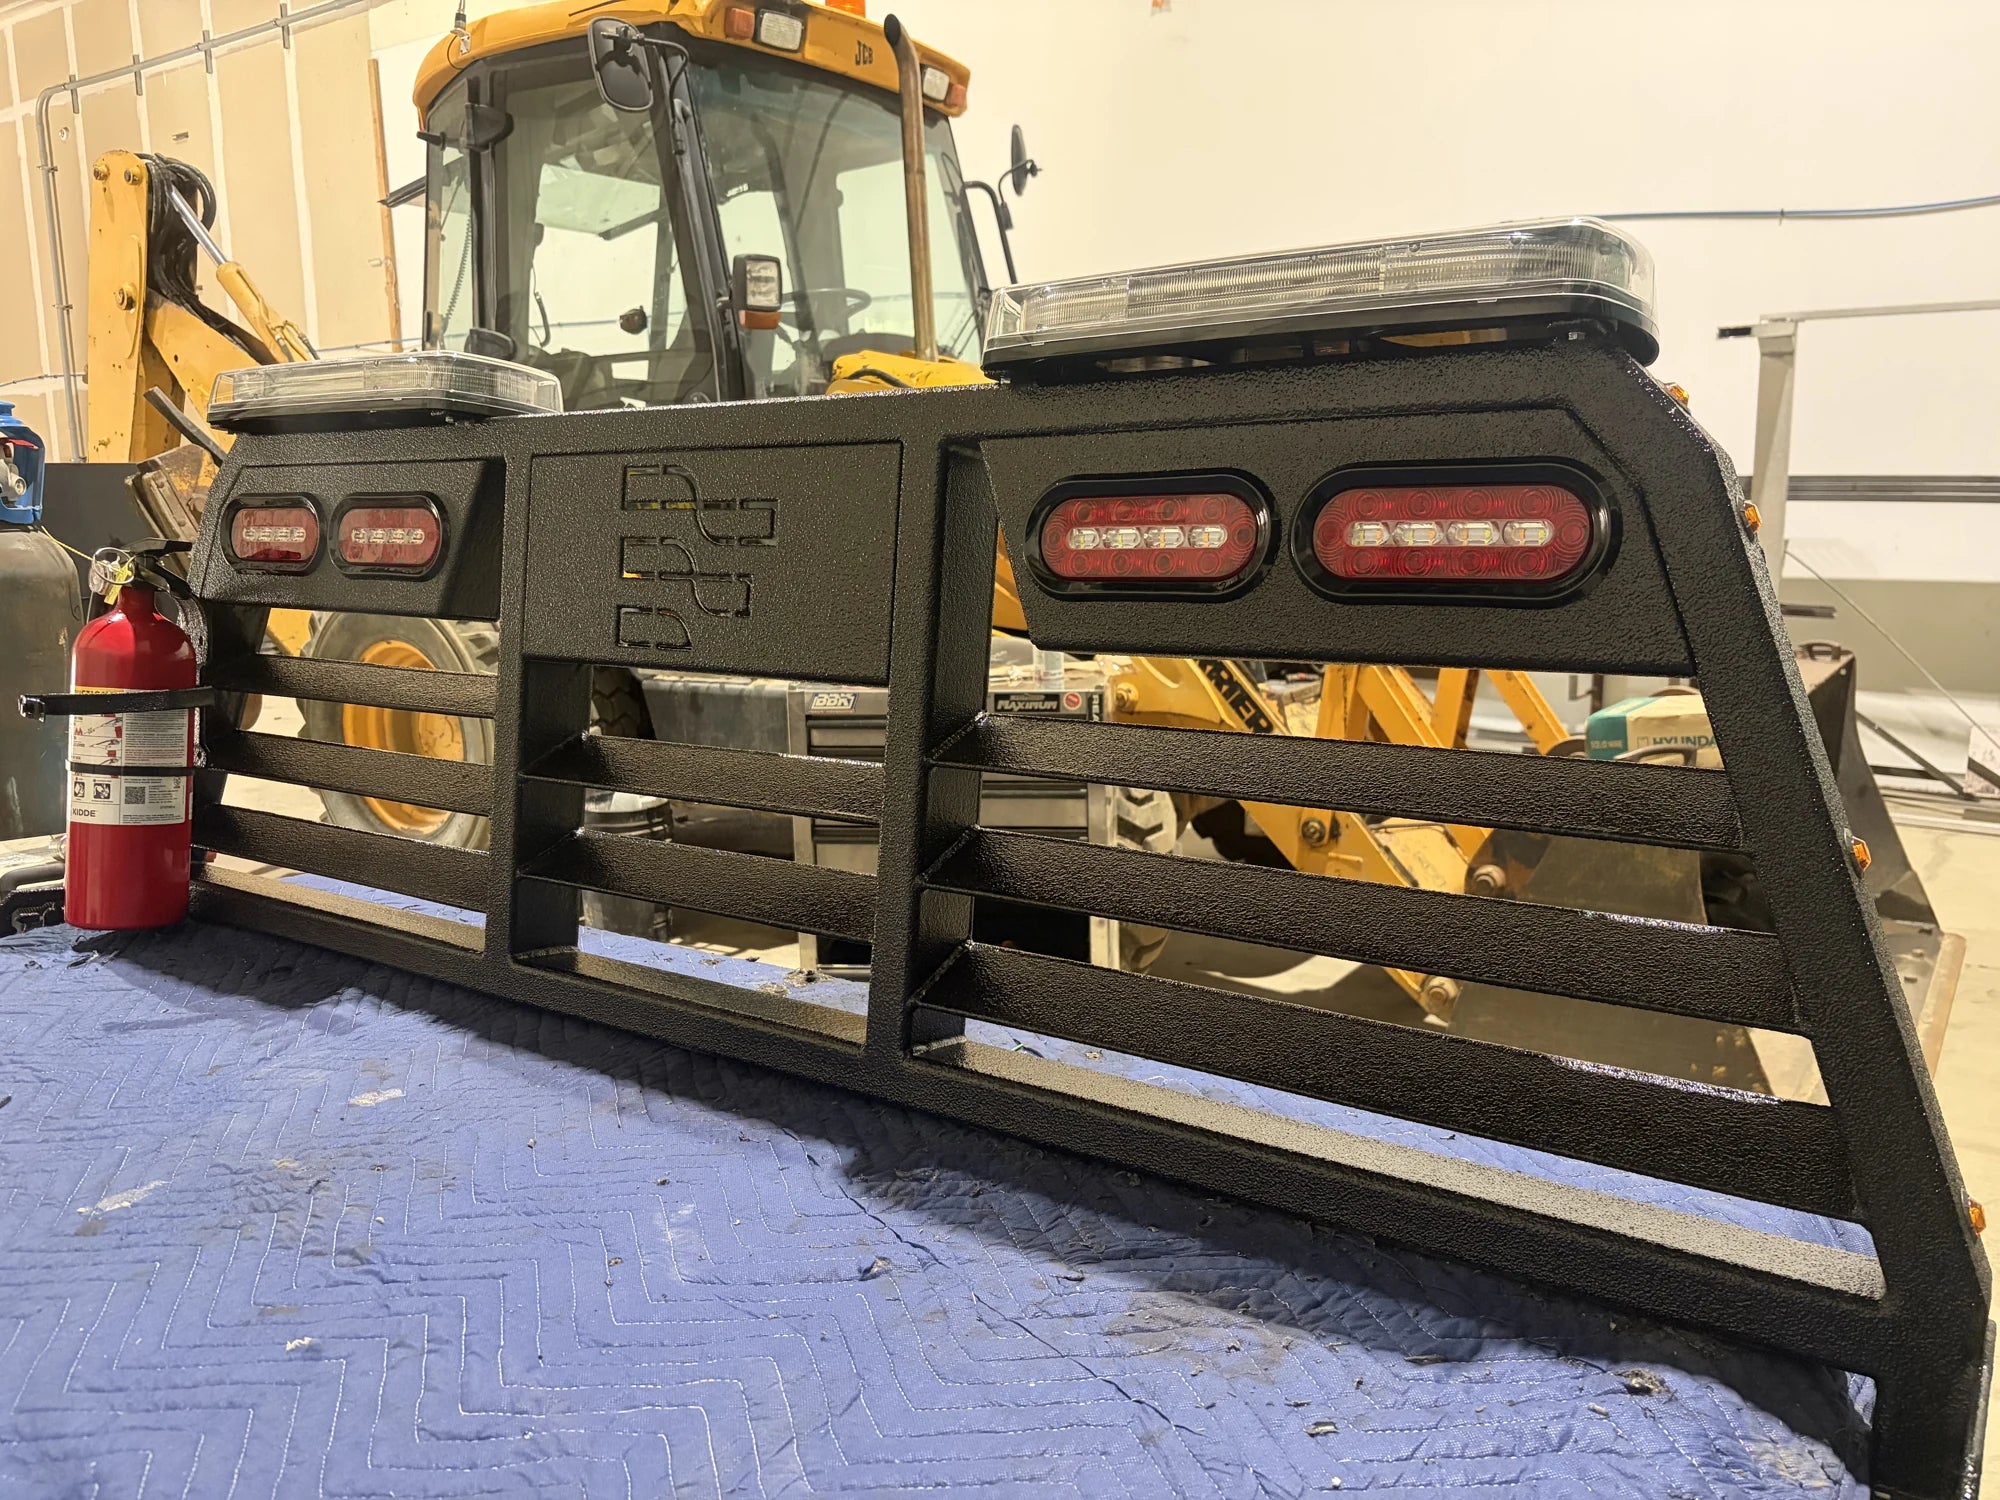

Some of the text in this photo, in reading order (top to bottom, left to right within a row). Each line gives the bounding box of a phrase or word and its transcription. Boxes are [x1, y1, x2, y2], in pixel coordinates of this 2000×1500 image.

[855, 40, 873, 66] JCB
[814, 693, 854, 708] BBK
[997, 700, 1058, 712] MAXIMUM
[72, 808, 96, 817] KIDDE
